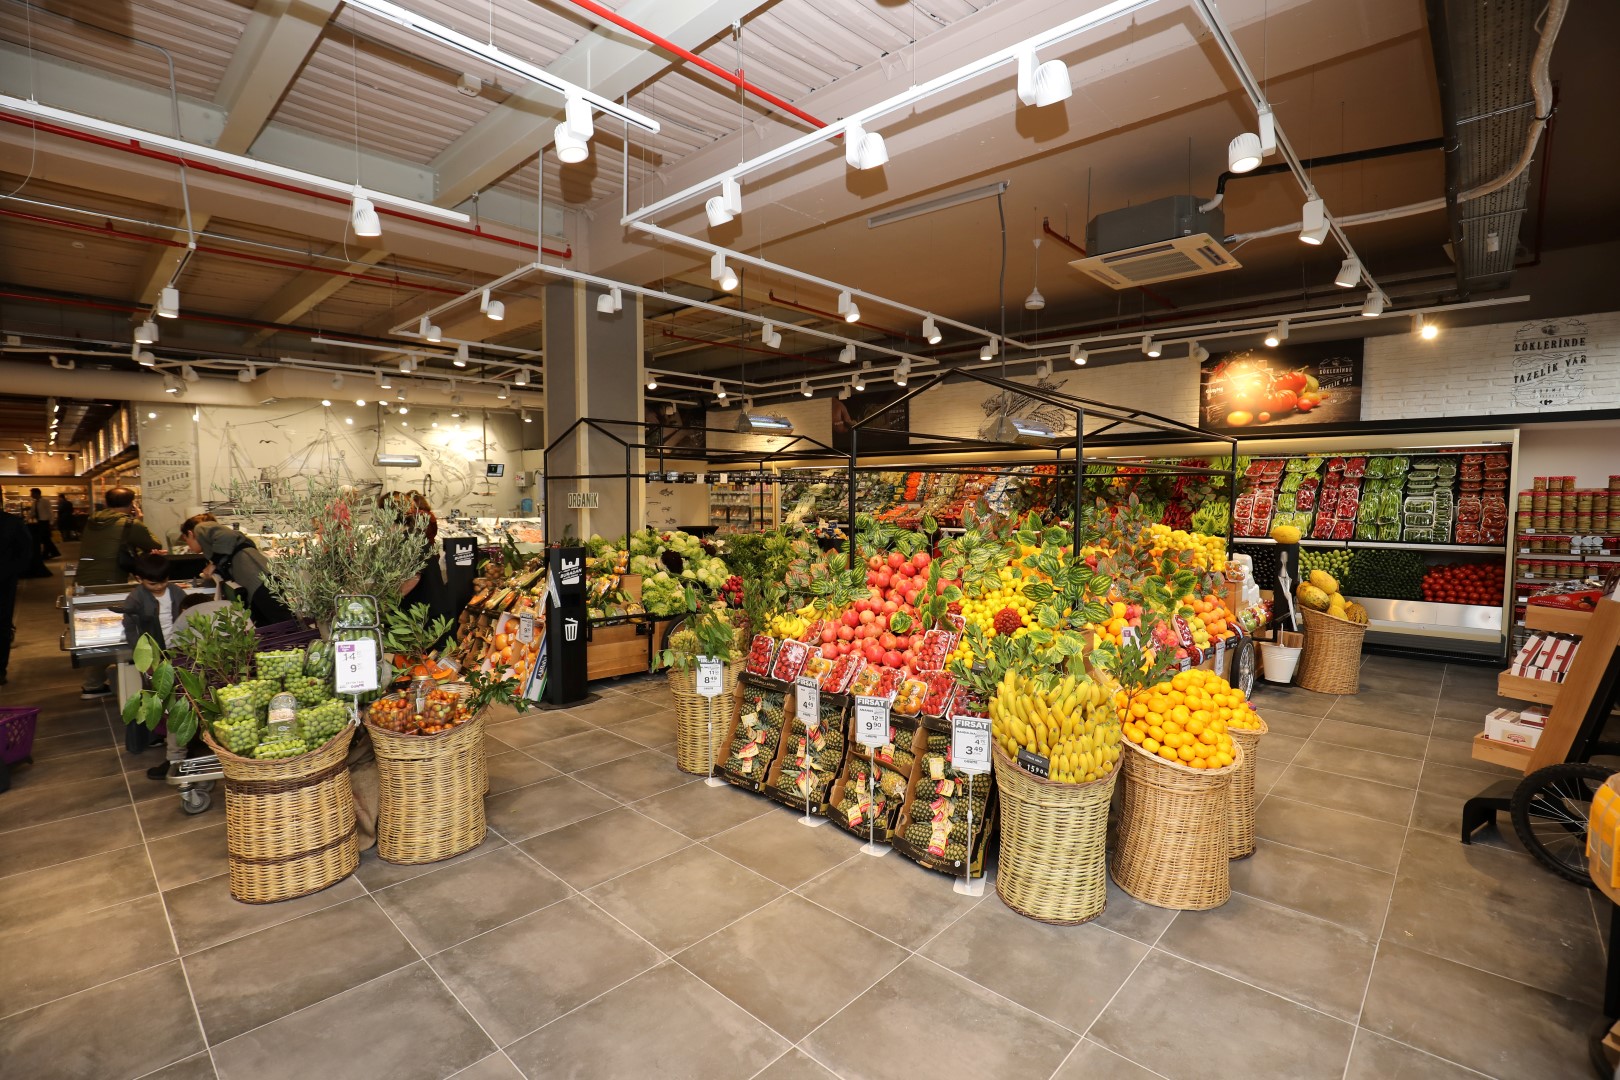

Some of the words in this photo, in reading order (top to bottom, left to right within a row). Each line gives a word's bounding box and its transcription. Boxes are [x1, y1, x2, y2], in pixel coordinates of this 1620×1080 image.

[1514, 337, 1586, 352] KÖKLERİNDE
[1513, 362, 1558, 384] TAZELİK
[1565, 355, 1587, 367] VAR
[350, 664, 357, 673] 9
[857, 697, 885, 706] FIRSAT
[955, 719, 989, 730] FIRSAT
